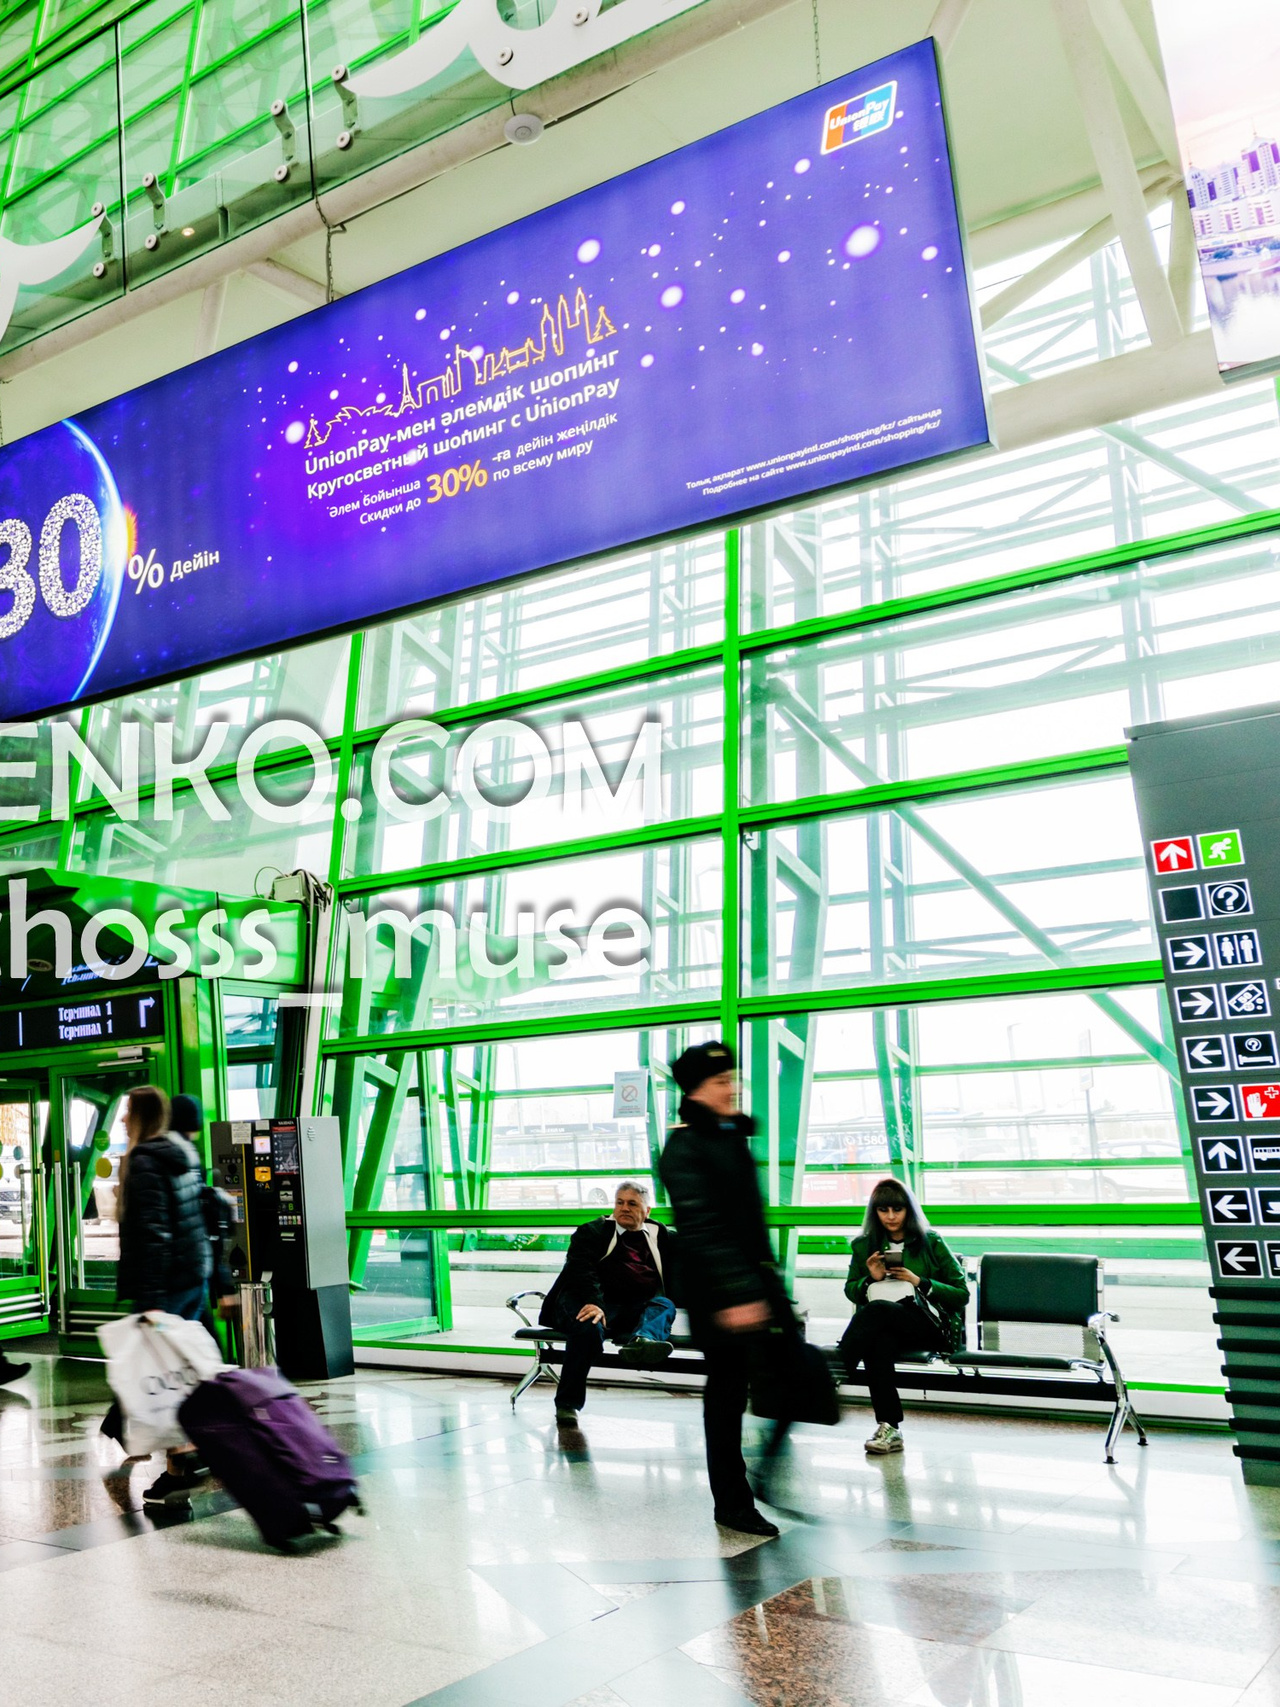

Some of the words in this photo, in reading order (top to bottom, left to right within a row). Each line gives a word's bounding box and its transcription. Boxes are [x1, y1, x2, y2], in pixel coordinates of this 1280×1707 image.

[304, 415, 436, 476] UnionPay-мен
[440, 383, 524, 426] әлемдік
[529, 350, 619, 395] шопинг
[307, 443, 428, 499] Кругосветный
[433, 421, 507, 456] шопинг
[510, 415, 522, 428] с
[526, 378, 620, 422] UnionPay
[897, 408, 942, 428] сайтында
[329, 500, 360, 518] Әлем
[362, 478, 421, 507] бойынша
[426, 459, 489, 504] 30%
[515, 434, 554, 458] дейін
[556, 412, 618, 442] жеңілдік
[359, 504, 404, 525] Скидки
[405, 497, 421, 515] до
[492, 465, 510, 482] по
[513, 453, 554, 477] всему
[556, 438, 594, 463] миру
[702, 476, 748, 496] Подробнее
[749, 472, 760, 482] на
[761, 465, 784, 479] сайте
[127, 548, 164, 595] %
